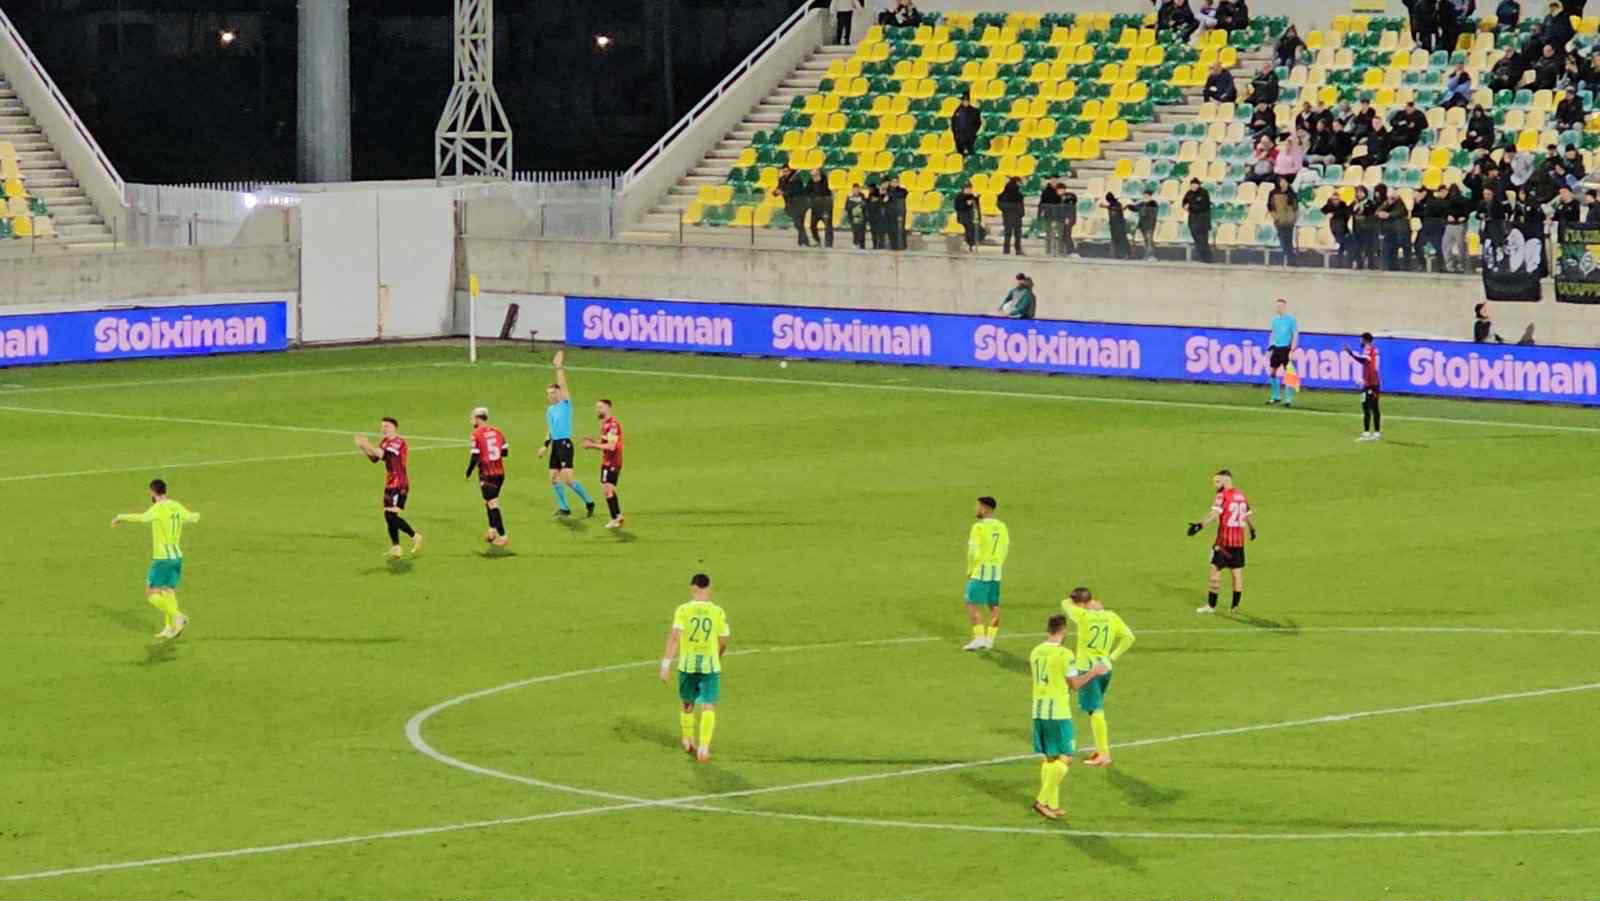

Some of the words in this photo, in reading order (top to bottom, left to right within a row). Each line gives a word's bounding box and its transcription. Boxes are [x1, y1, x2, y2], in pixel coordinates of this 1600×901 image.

[0, 324, 49, 358] an
[95, 315, 266, 353] Stoiximan
[583, 305, 733, 346] Stoiximan
[772, 313, 932, 356] Stoiximan
[974, 324, 1141, 370] Stoiximan
[1185, 335, 1363, 381] Stoixman
[1409, 346, 1597, 395] Stoiximan
[486, 437, 501, 461] 5
[169, 512, 181, 536] 11
[991, 532, 1001, 556] 7
[688, 616, 713, 643] 29
[1087, 624, 1109, 650] 21
[1034, 656, 1049, 687] 14
